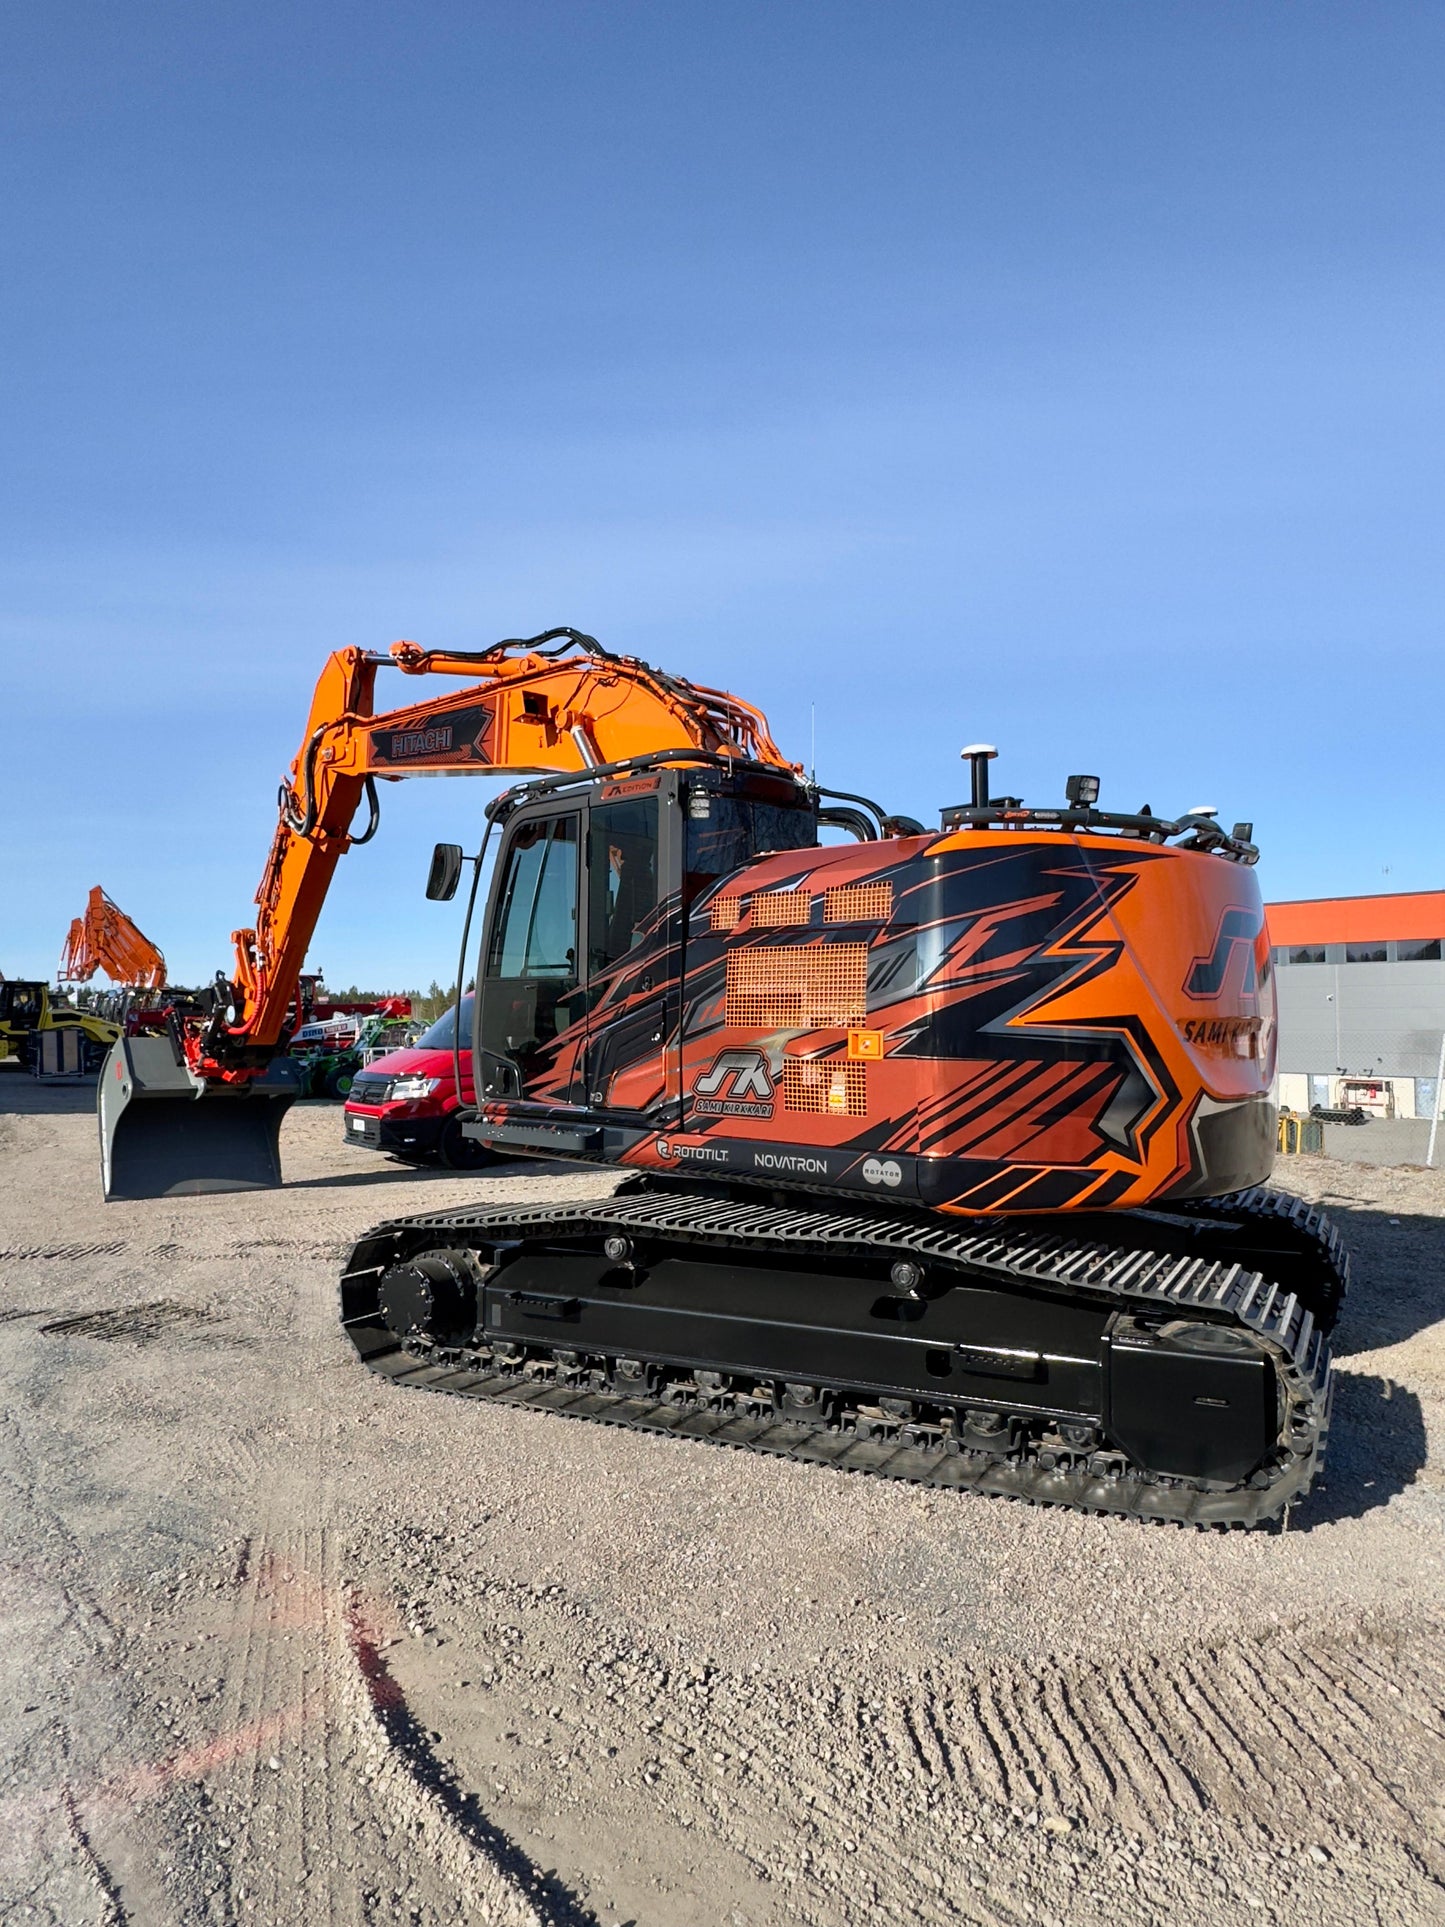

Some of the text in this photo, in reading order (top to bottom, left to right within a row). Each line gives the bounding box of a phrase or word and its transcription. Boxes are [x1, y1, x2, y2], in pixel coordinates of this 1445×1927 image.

[392, 726, 453, 757] HITACHI
[622, 782, 652, 793] EDITION
[1183, 1020, 1229, 1044] SAMI
[696, 1100, 772, 1117] SAMI KIRKKARI
[673, 1145, 729, 1162] ROTOTILT
[754, 1153, 828, 1174] NOVATRON
[864, 1168, 900, 1178] ROTATOR
